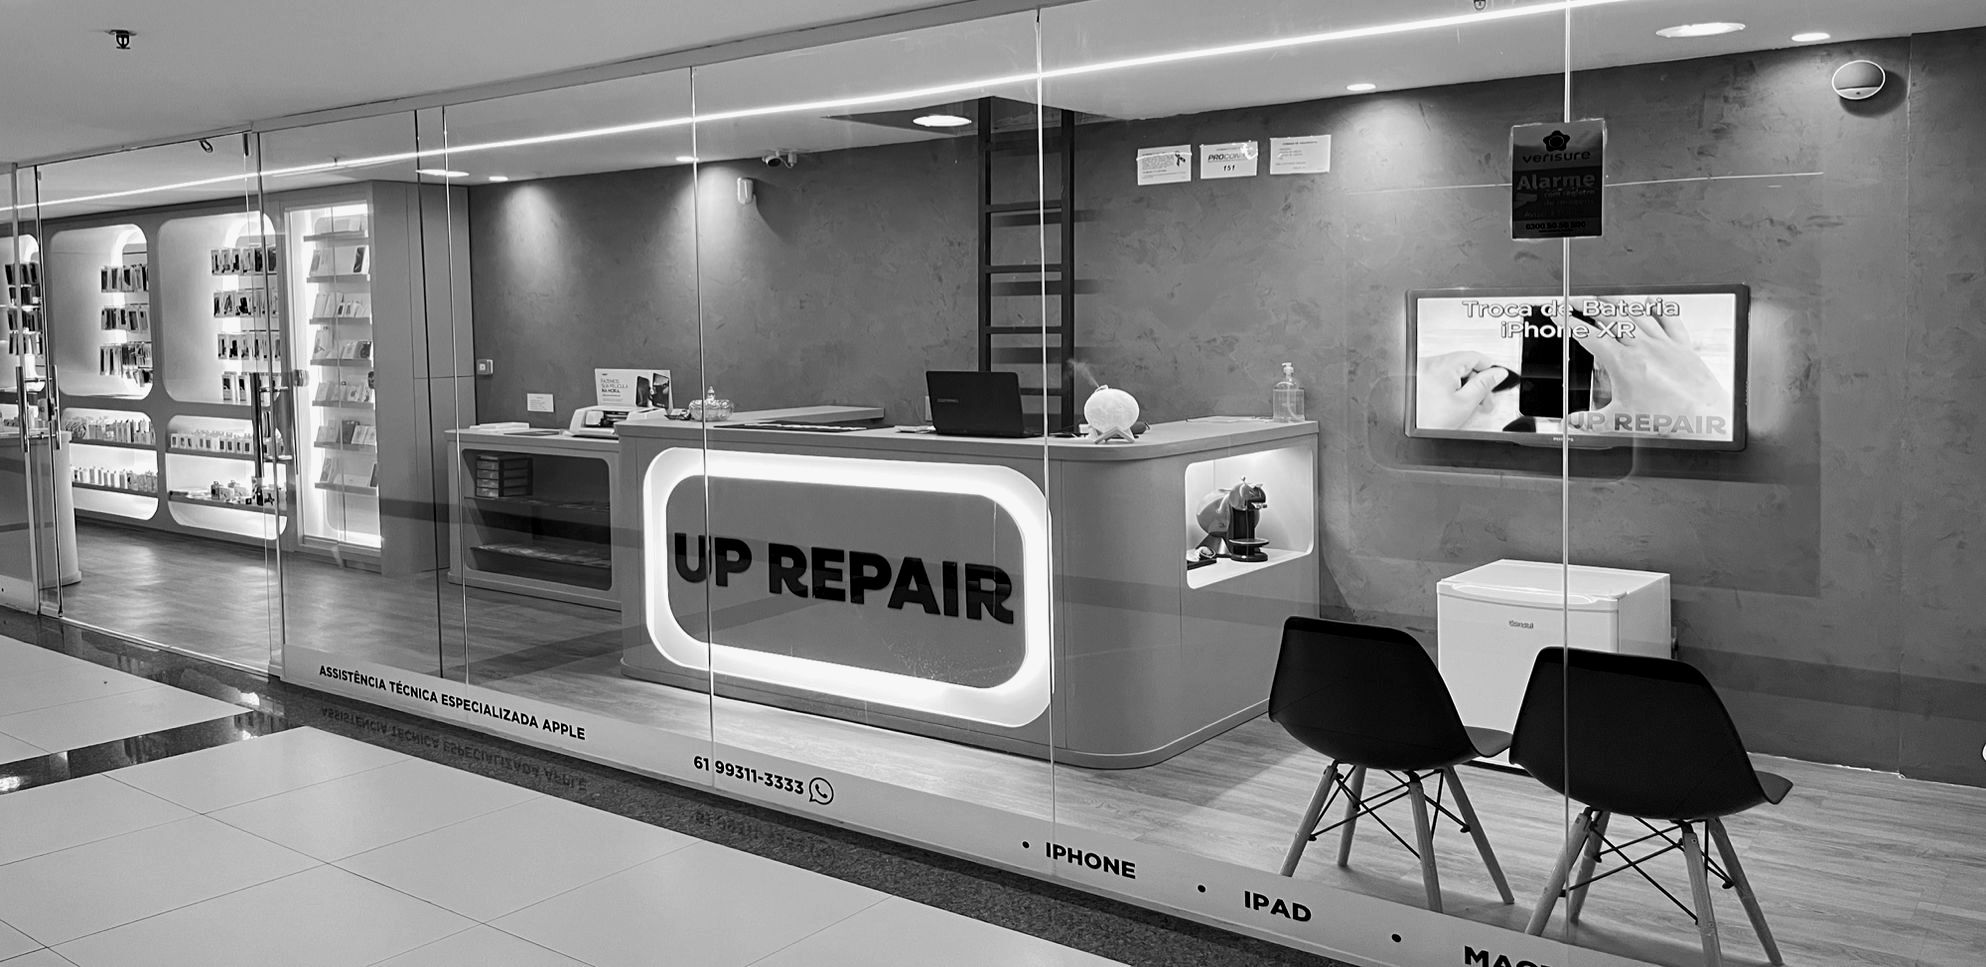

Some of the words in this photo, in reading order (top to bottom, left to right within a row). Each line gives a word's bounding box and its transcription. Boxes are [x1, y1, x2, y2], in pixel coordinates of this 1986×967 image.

[1522, 151, 1591, 164] verisure
[1517, 174, 1595, 191] Alarme
[1462, 300, 1533, 318] Troca
[1541, 298, 1575, 318] de
[1583, 297, 1680, 318] Bateria
[1500, 321, 1589, 339] iPhone
[1597, 321, 1635, 339] XR
[1569, 412, 1605, 432] UP
[1614, 413, 1727, 434] REPAIR
[674, 532, 753, 588] UP
[768, 542, 1014, 625] REPAIR
[319, 665, 387, 692] ASSISTÊNCIA
[389, 680, 439, 704] TÉCNICA
[441, 694, 539, 729] ESPECIALIZADA
[542, 718, 586, 741] APPLE
[693, 755, 710, 771] 61
[714, 760, 804, 795] 99311-3333
[1045, 841, 1136, 880] IPHONE
[1244, 890, 1312, 922] IPAD
